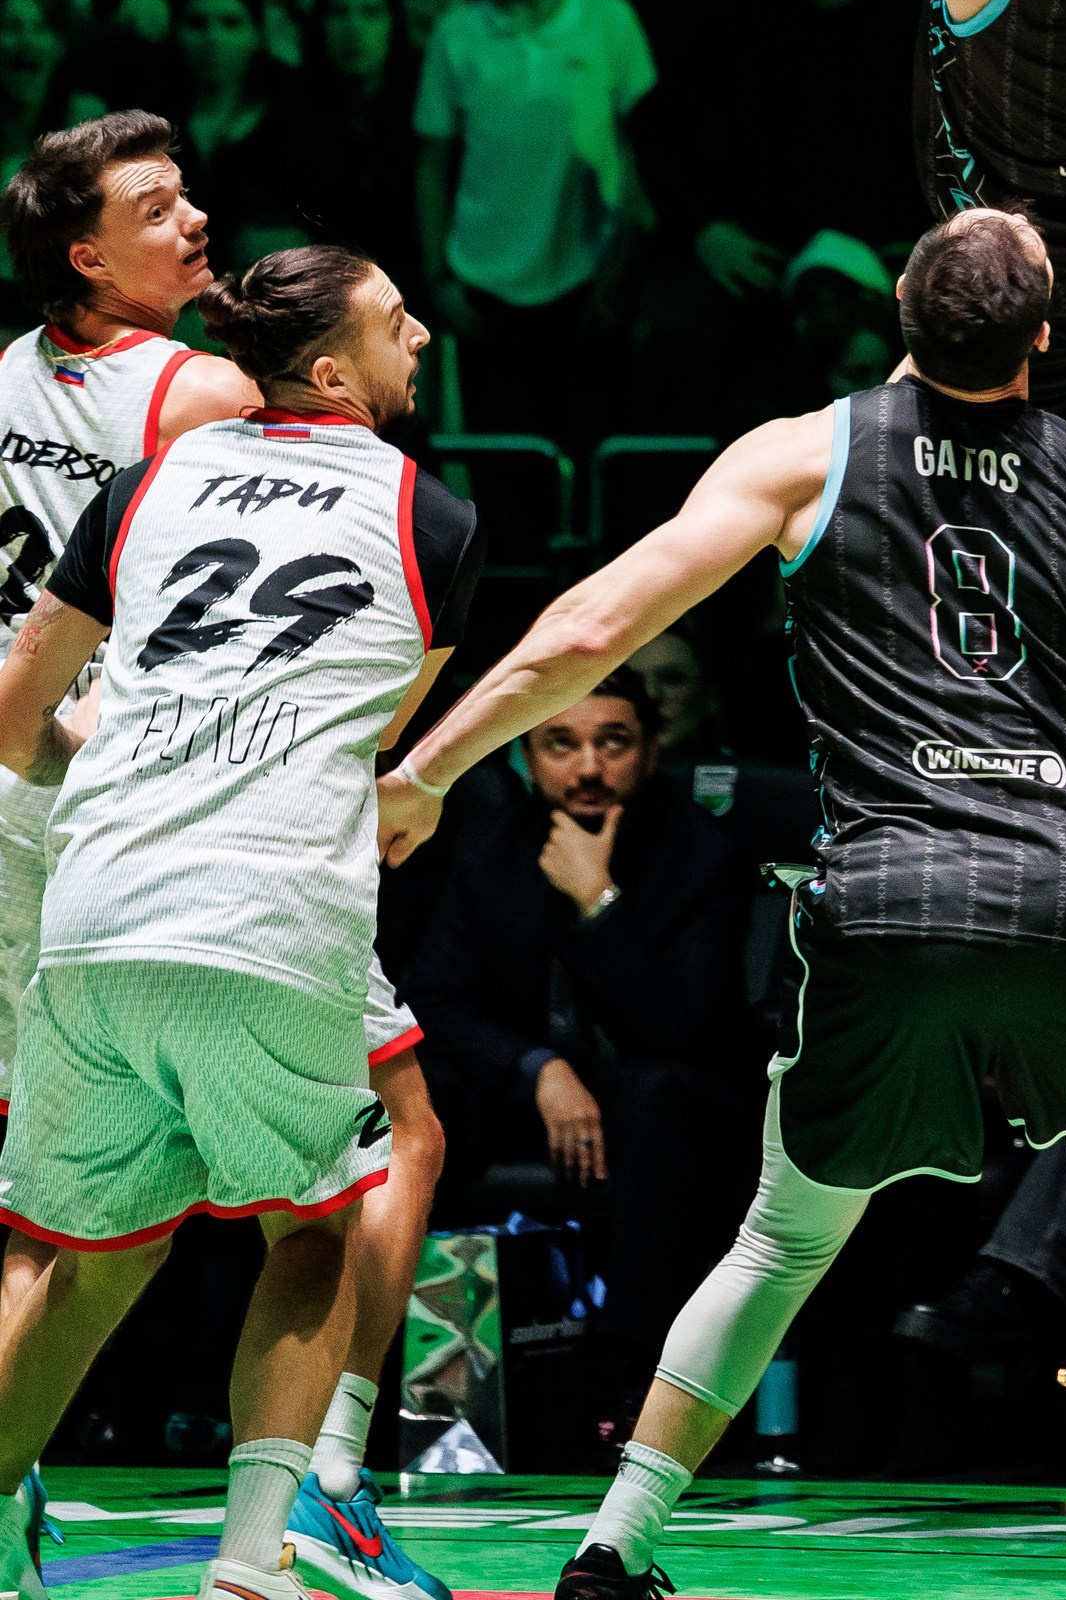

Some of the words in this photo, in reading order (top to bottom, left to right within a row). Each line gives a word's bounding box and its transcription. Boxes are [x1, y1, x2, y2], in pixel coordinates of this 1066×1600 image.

[0, 427, 124, 488] DERSO
[914, 436, 1021, 494] GATOS
[136, 537, 375, 679] 29
[925, 523, 1028, 682] 8
